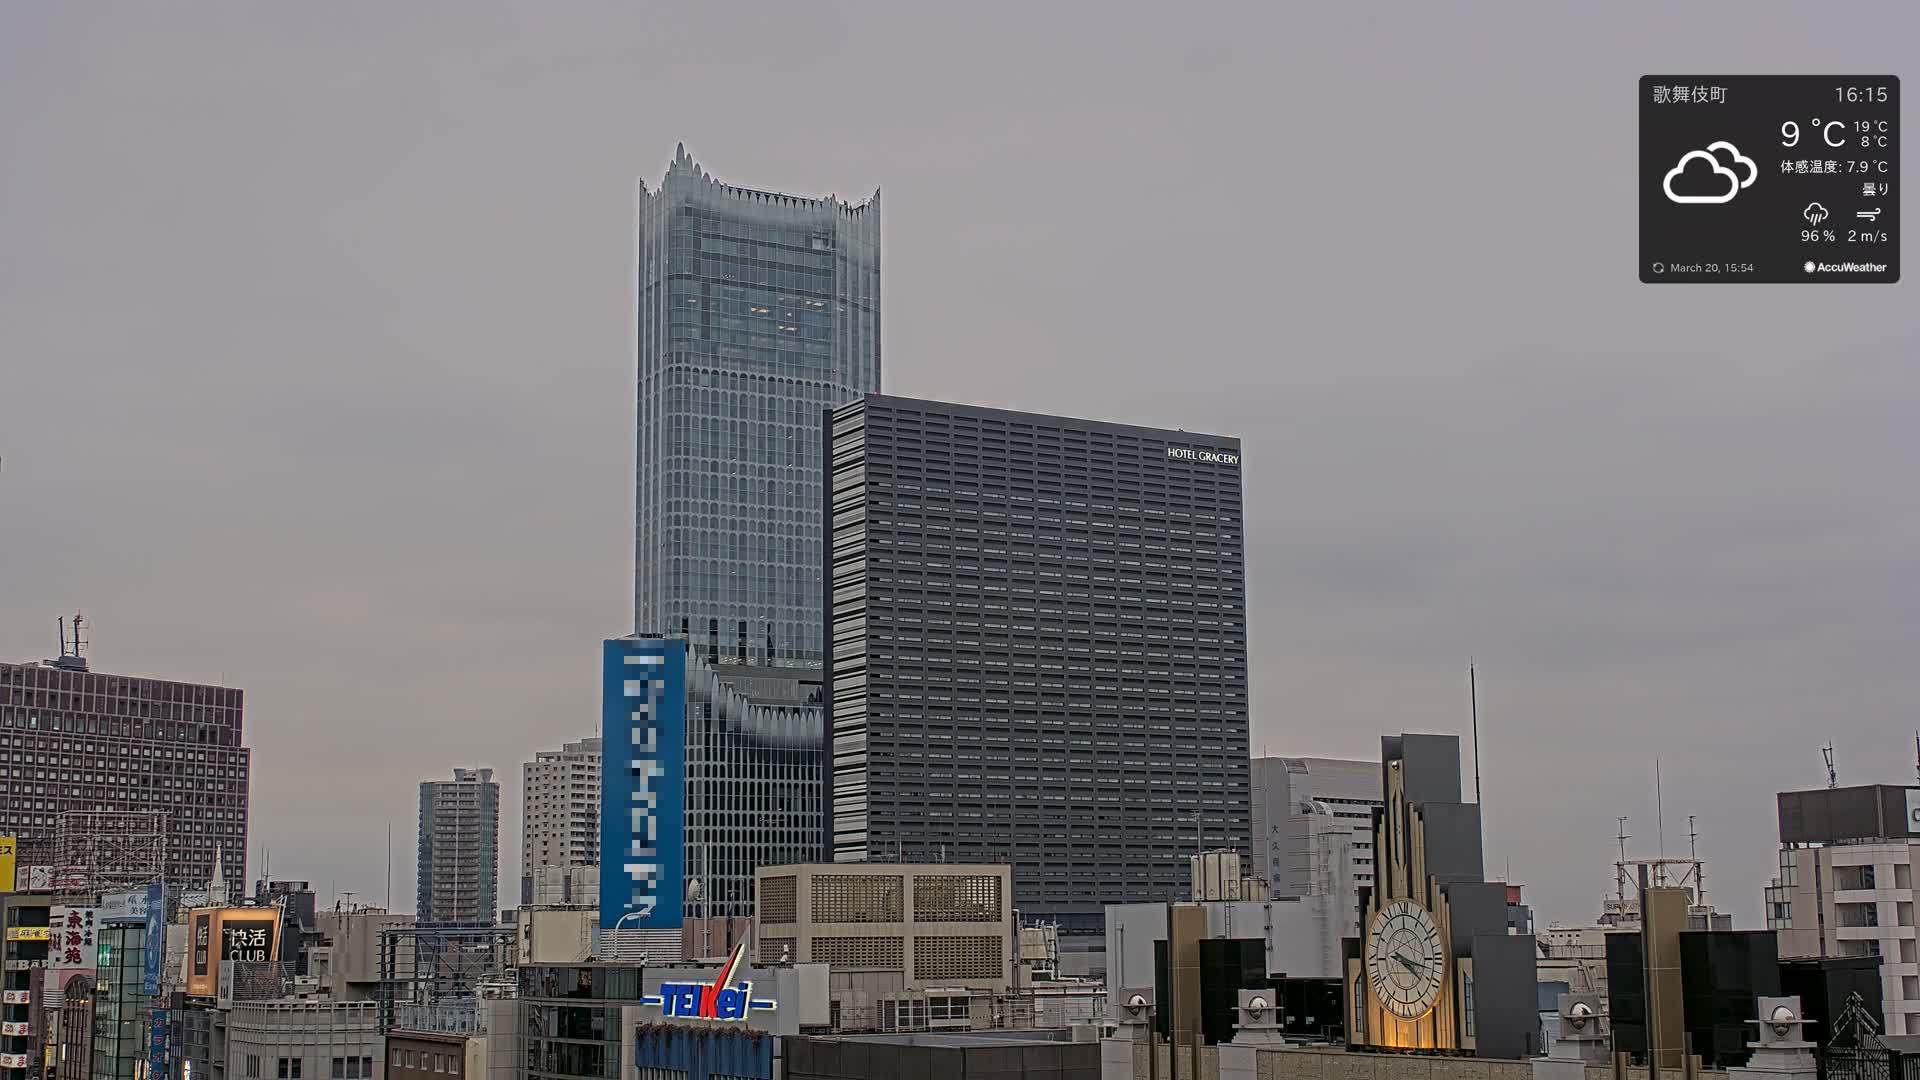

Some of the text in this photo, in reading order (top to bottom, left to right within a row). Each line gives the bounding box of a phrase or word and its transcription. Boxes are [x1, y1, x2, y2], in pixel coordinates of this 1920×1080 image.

[1167, 447, 1239, 465] HOTEL GRACERY
[64, 910, 83, 964] 東海苑
[231, 928, 267, 948] 快活
[230, 949, 266, 962] CLUB
